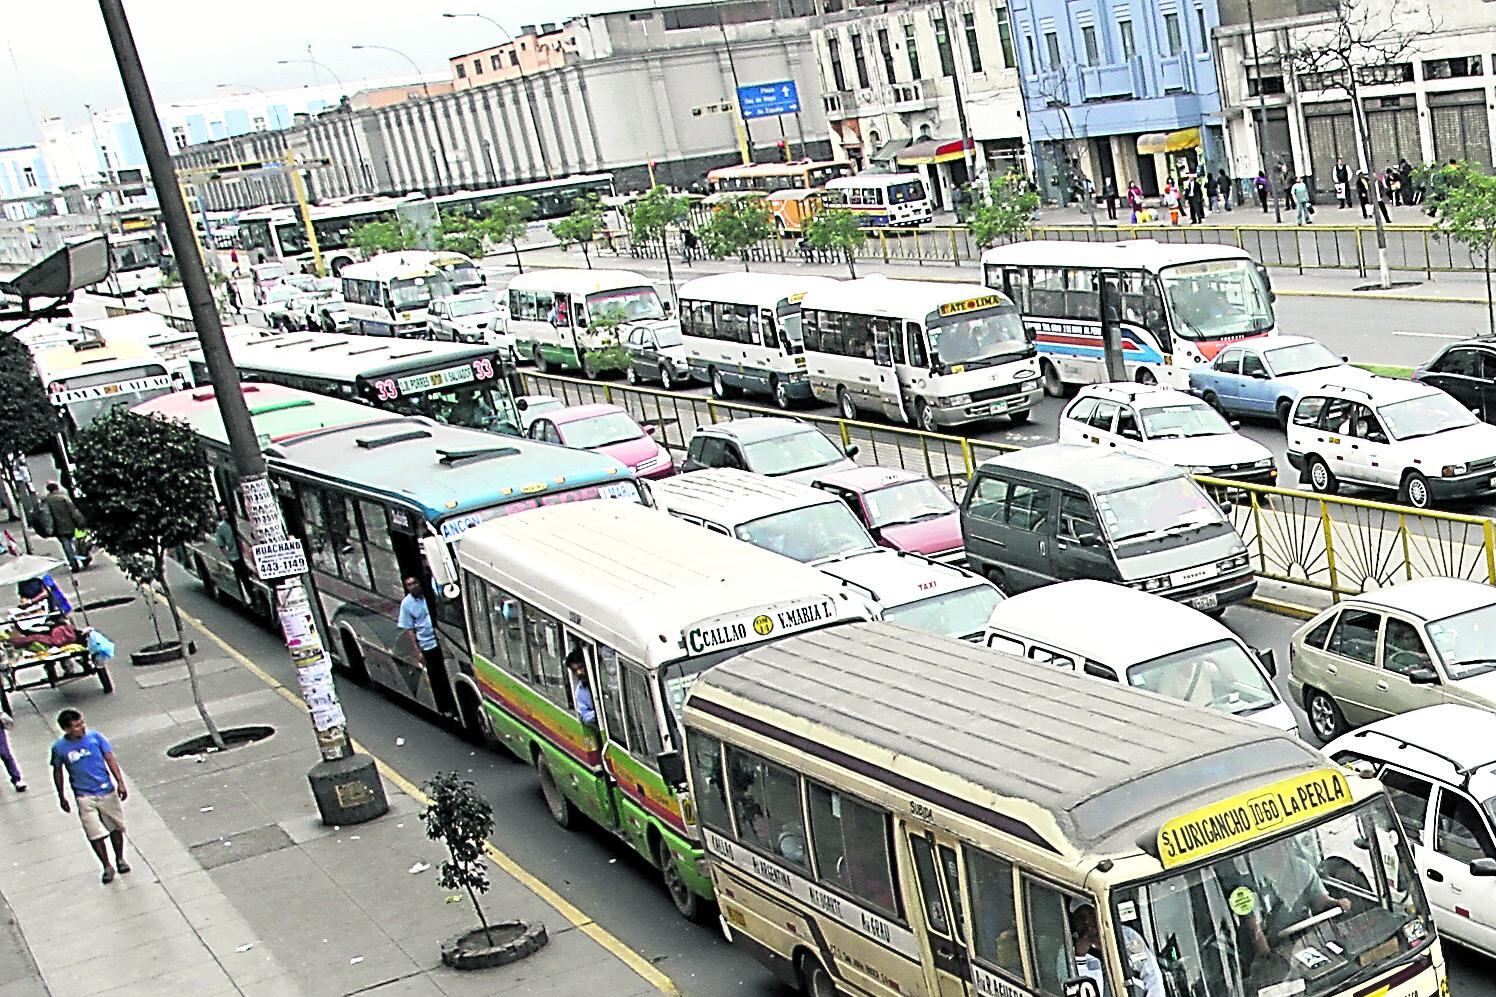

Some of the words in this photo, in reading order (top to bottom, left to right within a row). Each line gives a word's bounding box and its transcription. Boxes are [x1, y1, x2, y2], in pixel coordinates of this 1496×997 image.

[975, 295, 999, 308] LIMA
[472, 358, 494, 380] 33
[375, 379, 398, 401] 33
[260, 558, 305, 573] 443-1149
[1183, 570, 1207, 580] TOYOTA
[917, 582, 937, 592] TAXI
[703, 623, 747, 647] CALLAO
[1172, 806, 1251, 854] LURIGANCHO
[1296, 774, 1345, 811] PERLA
